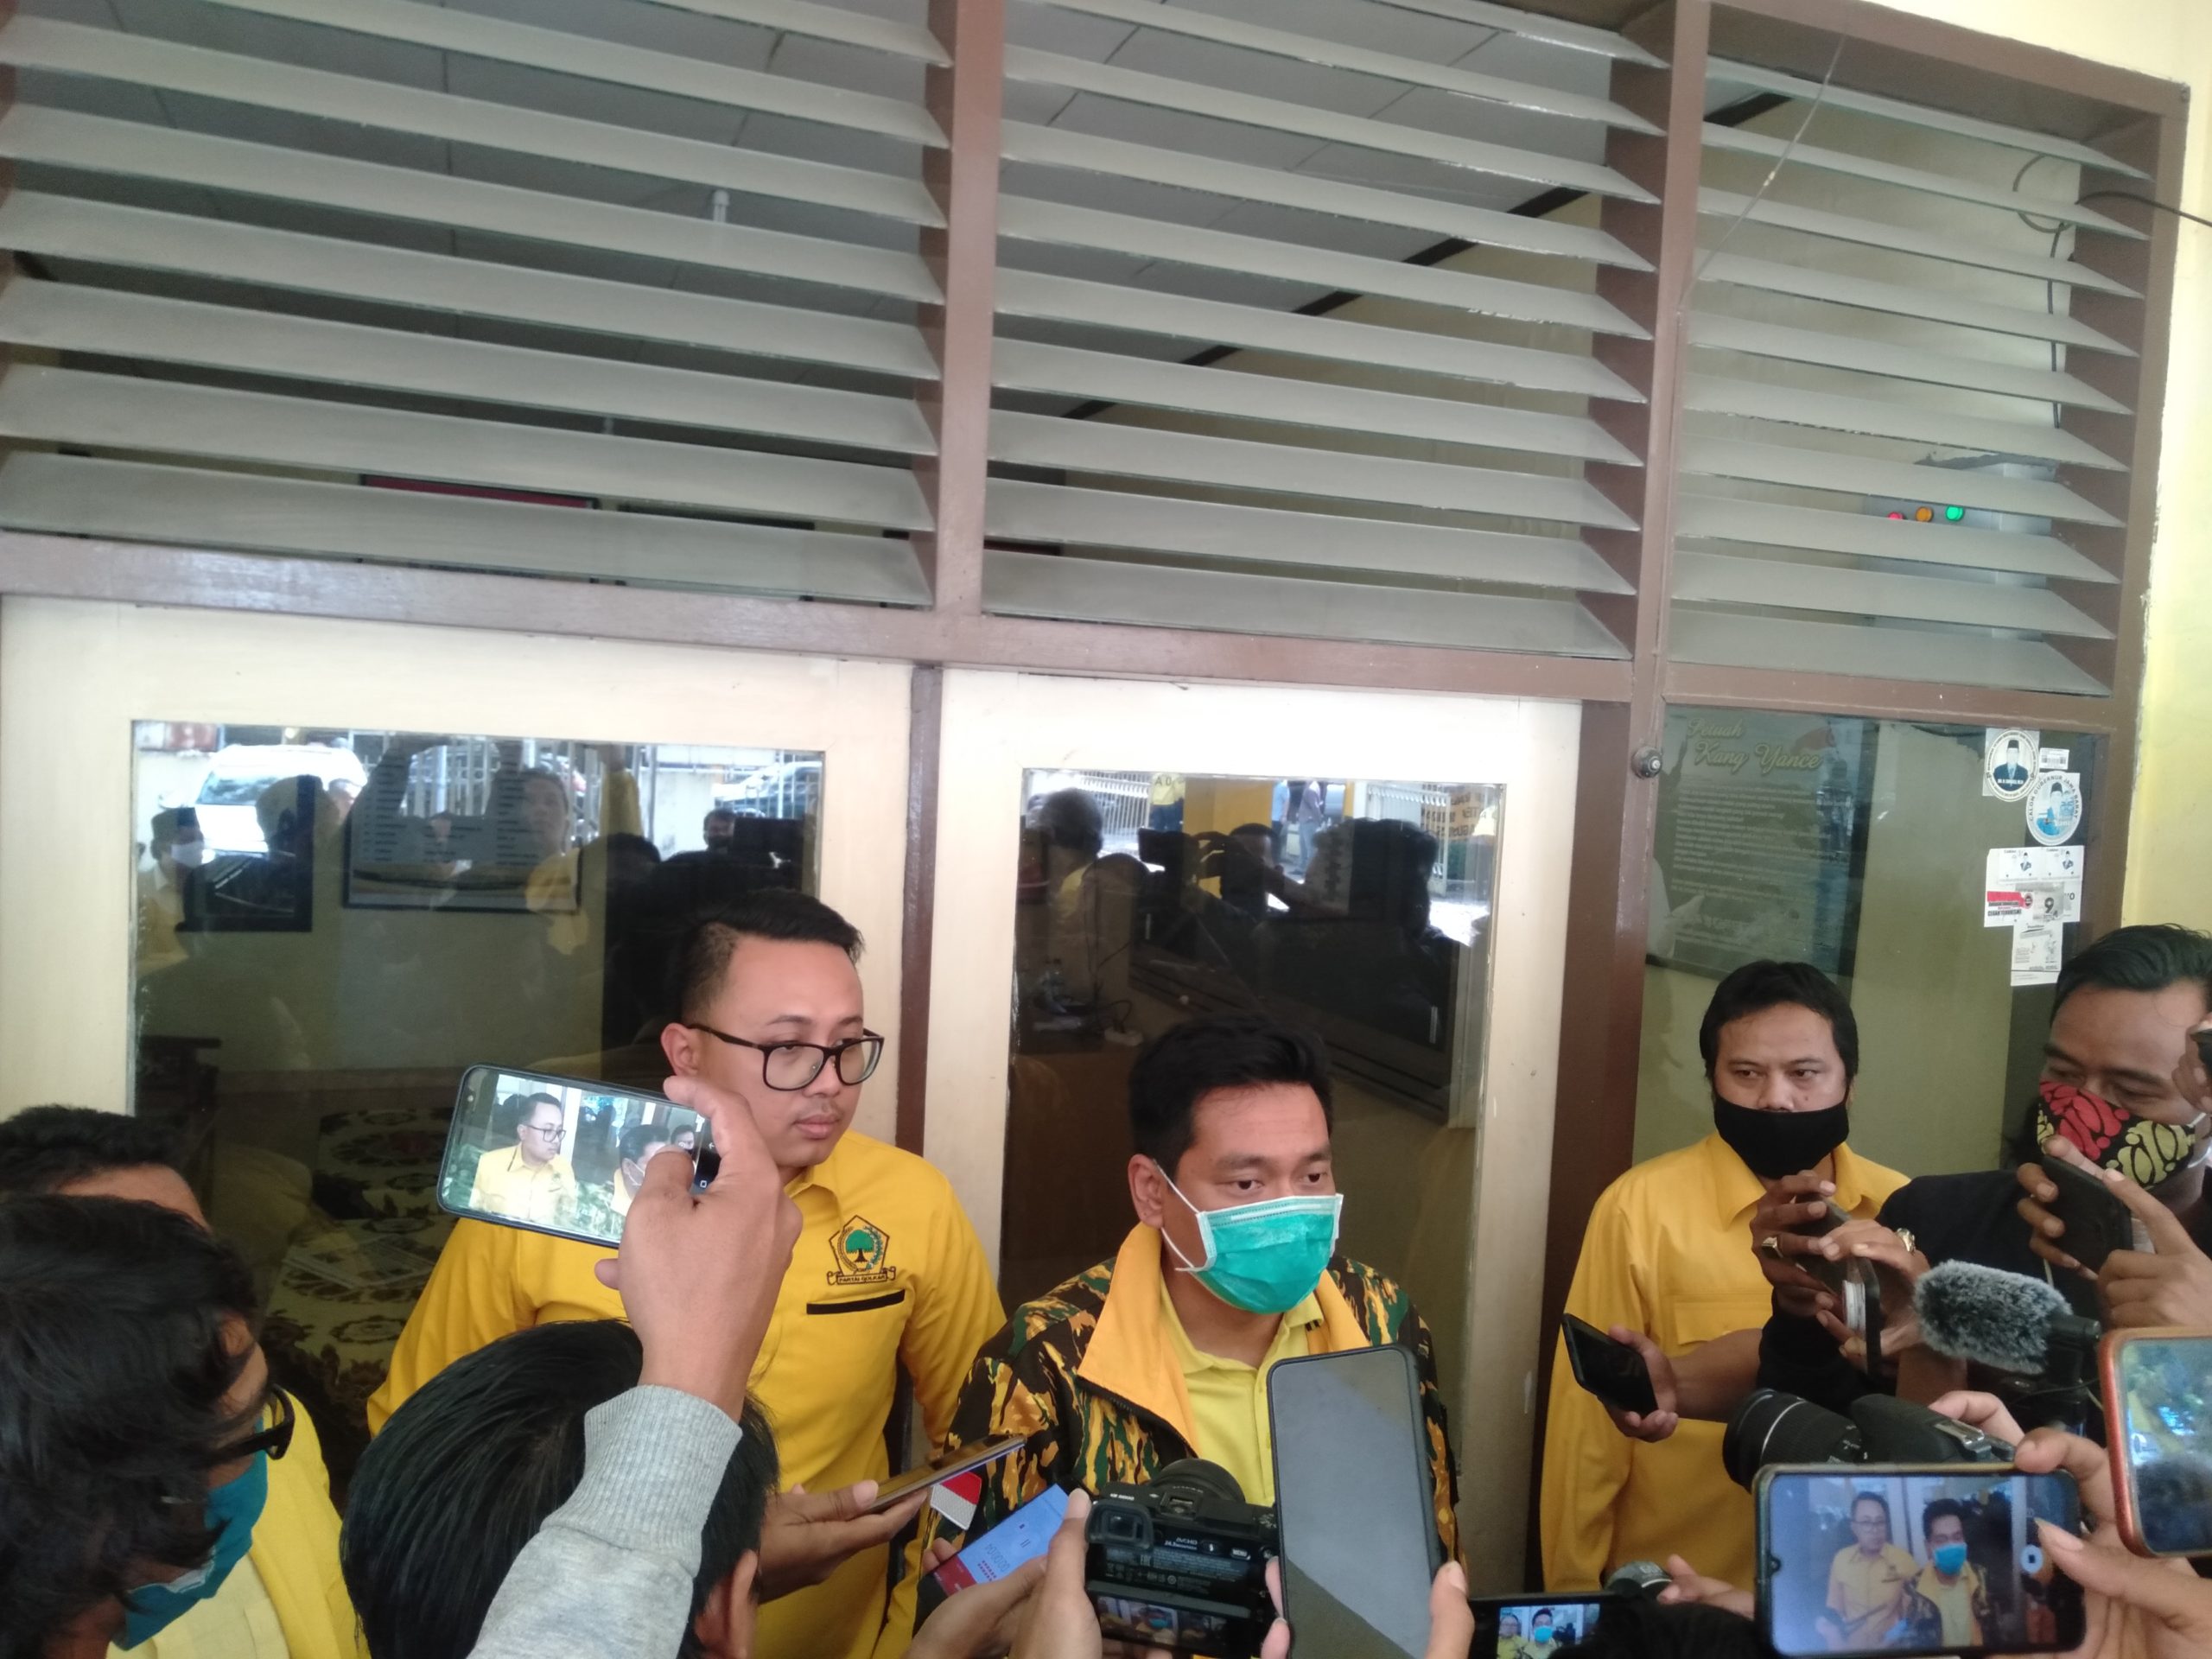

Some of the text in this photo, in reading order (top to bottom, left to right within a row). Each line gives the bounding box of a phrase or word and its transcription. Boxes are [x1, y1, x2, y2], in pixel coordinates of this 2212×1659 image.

[1694, 742, 1822, 773] Kang Yance
[2034, 774, 2063, 794] GUBERNUR
